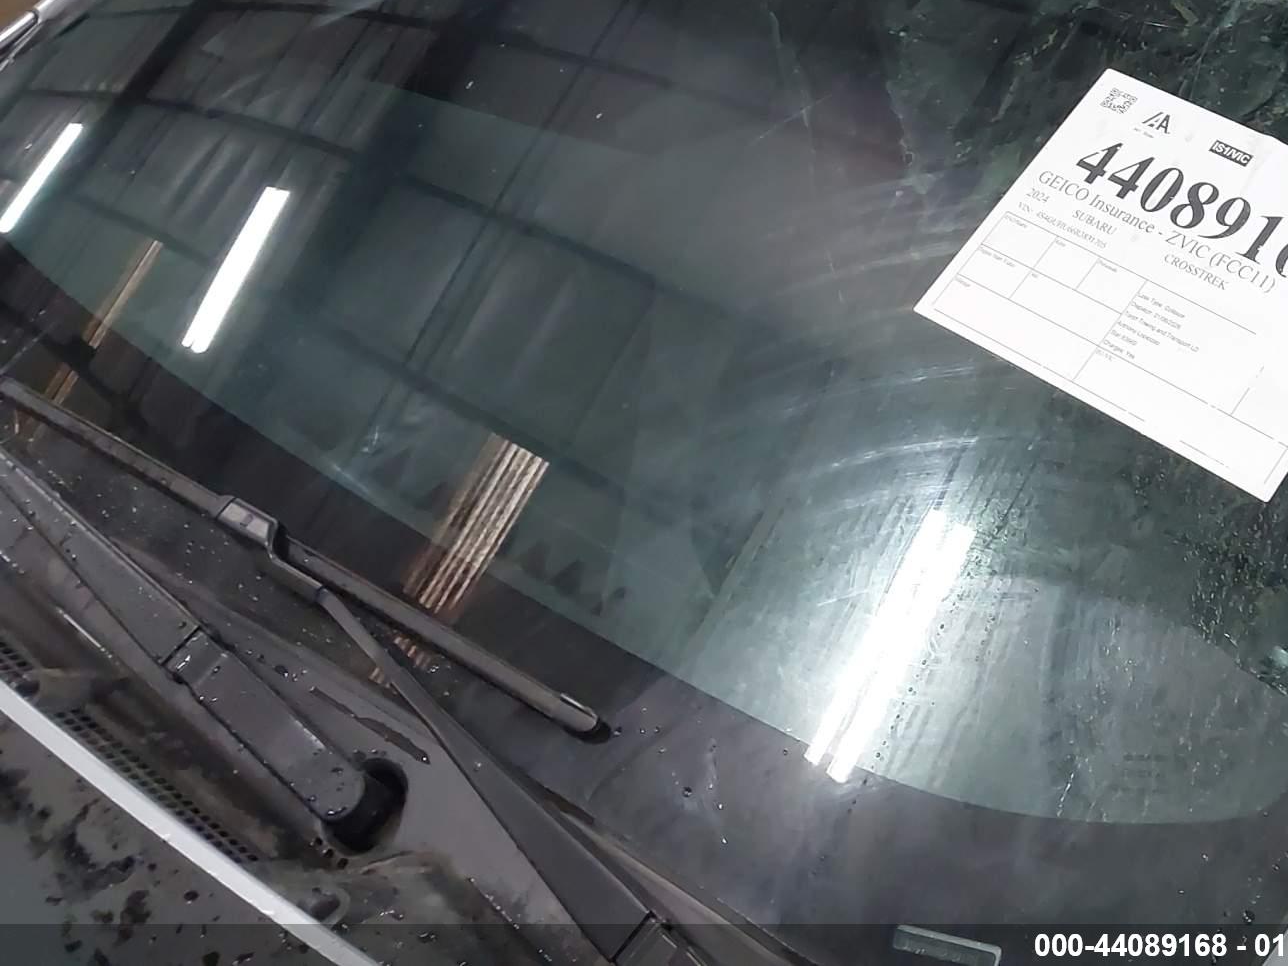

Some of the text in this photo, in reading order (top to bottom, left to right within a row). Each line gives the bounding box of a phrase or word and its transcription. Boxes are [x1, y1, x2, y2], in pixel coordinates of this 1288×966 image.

[1026, 188, 1050, 203] 2024
[1039, 171, 1089, 200] GEICO
[1089, 194, 1155, 233] Insurance
[1165, 230, 1211, 258] ZVIC
[1072, 210, 1118, 235] SUBARU
[1165, 255, 1228, 290] CROSSTREK
